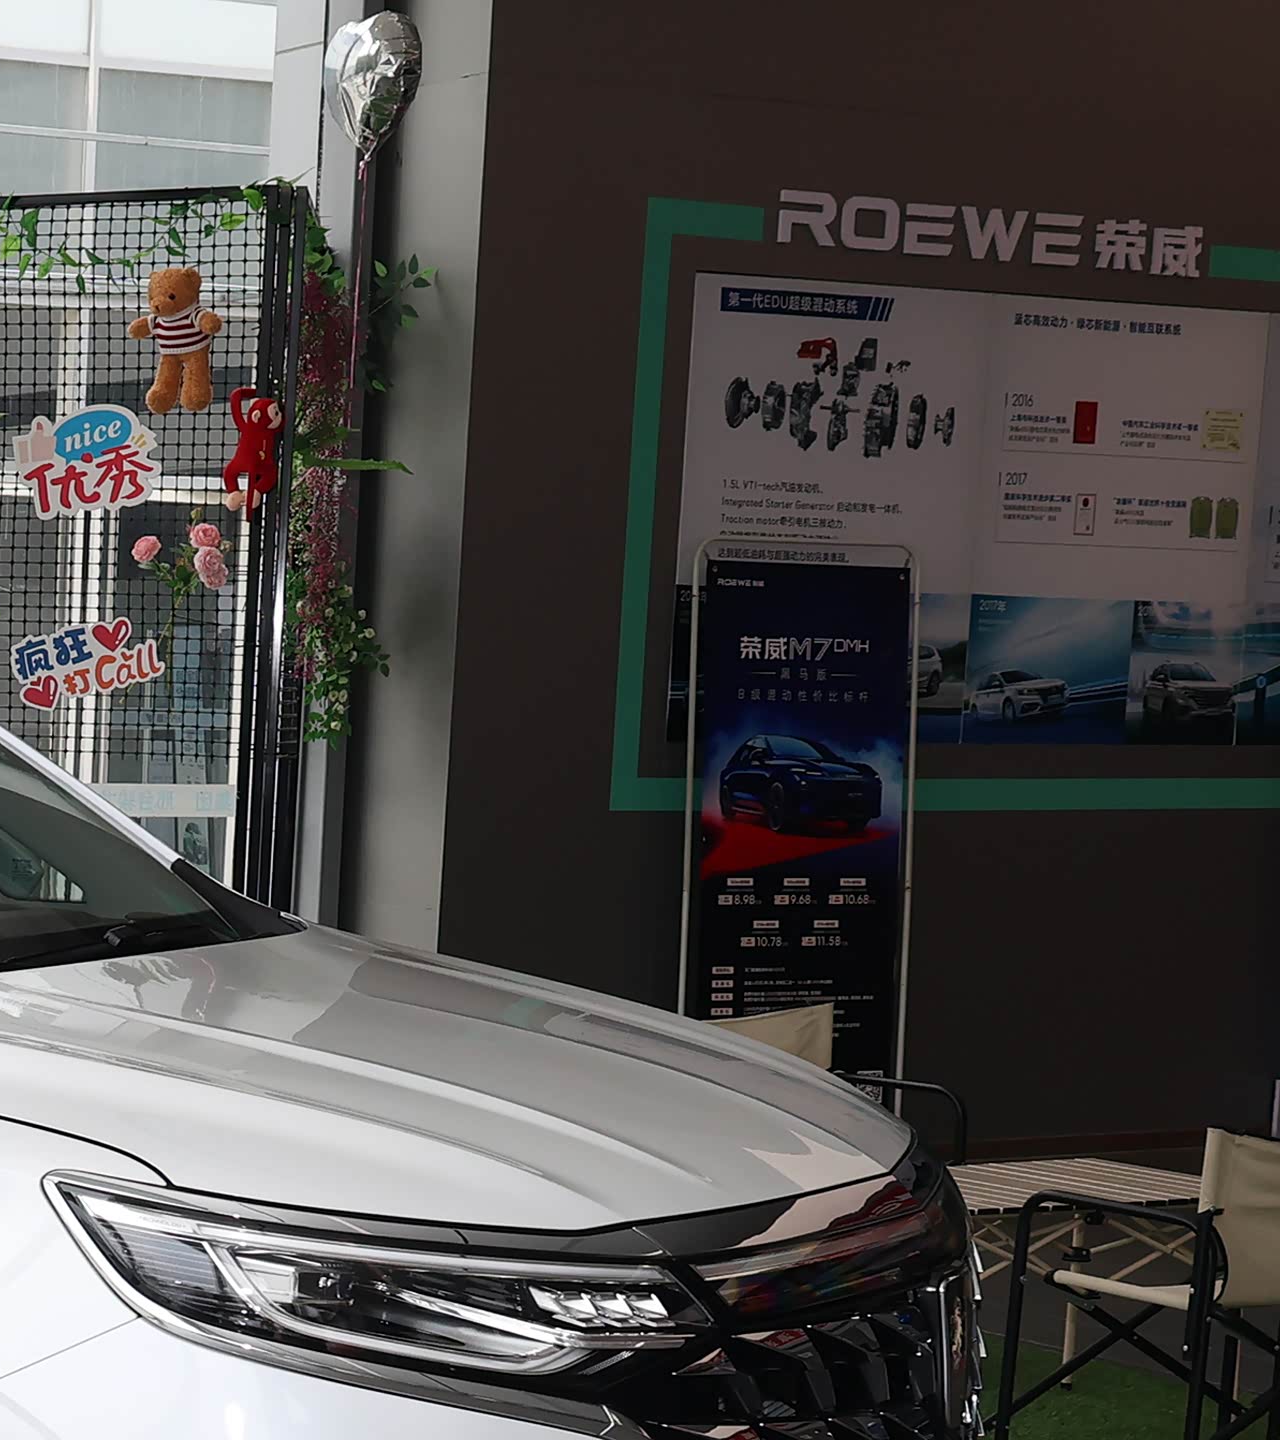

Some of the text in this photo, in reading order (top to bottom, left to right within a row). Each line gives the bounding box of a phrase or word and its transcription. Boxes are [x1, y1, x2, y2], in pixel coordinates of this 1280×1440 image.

[776, 188, 1204, 279] ROEWE 荣威
[728, 292, 859, 316] 第一代EDU超级混动系统
[1012, 394, 1034, 408] 2016
[64, 420, 123, 453] nice
[24, 444, 154, 514] 优秀
[1006, 472, 1027, 486] 2017
[765, 498, 793, 510] Starter
[14, 627, 93, 681] 疯狂
[734, 893, 756, 906] 8.98
[789, 894, 811, 906] 9.68
[844, 893, 870, 906] 10.68
[756, 936, 783, 948] 10.78
[816, 936, 841, 947] 11.58
